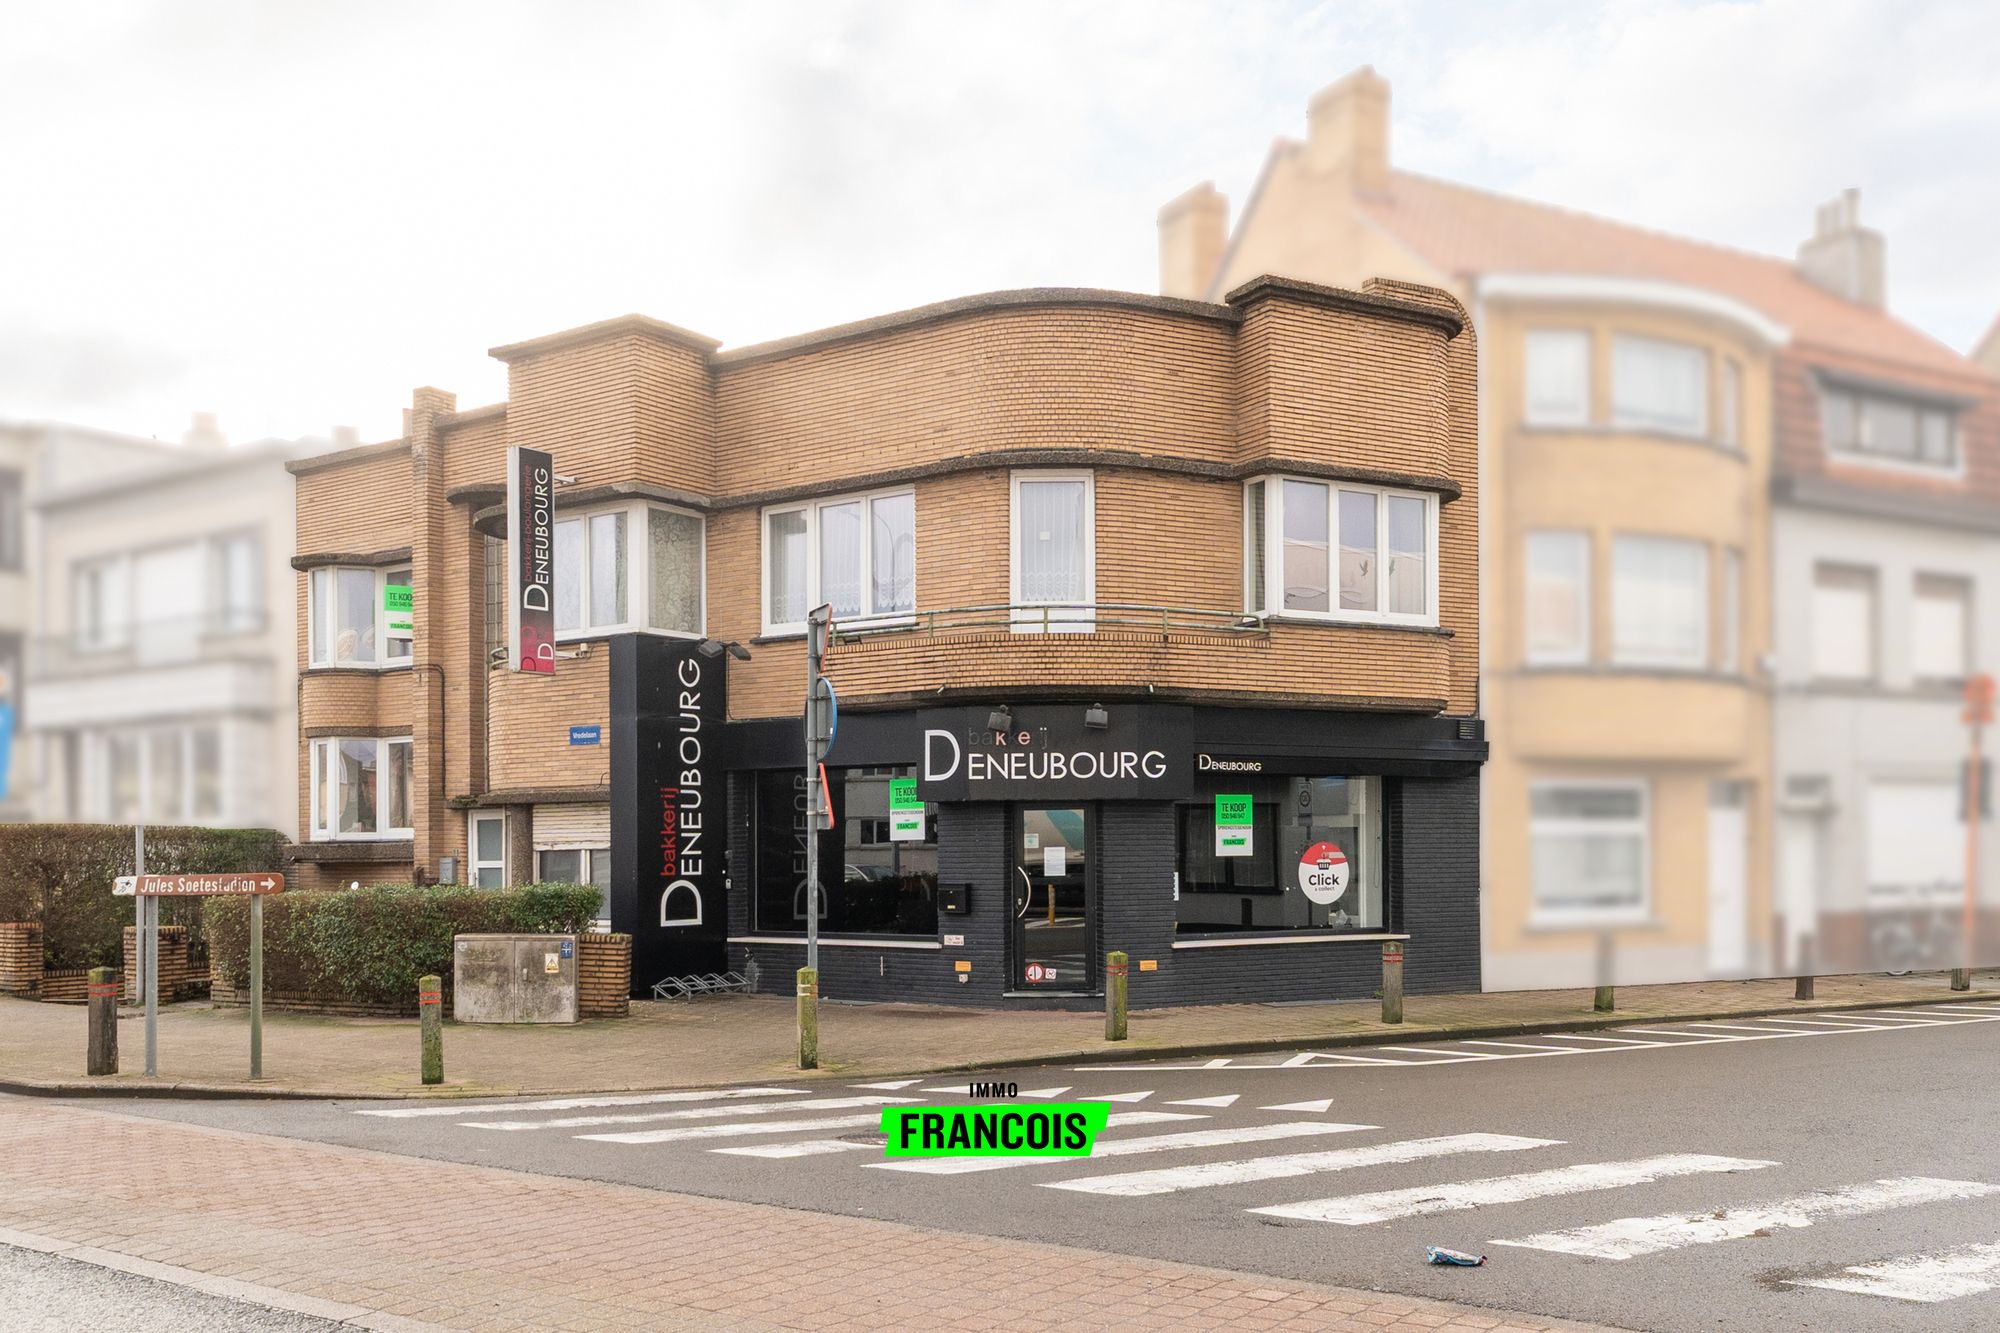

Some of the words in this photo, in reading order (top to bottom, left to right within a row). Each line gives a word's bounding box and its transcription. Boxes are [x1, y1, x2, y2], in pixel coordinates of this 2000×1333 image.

[524, 467, 549, 612] DENEUBOURG
[390, 592, 397, 600] TE
[399, 593, 412, 601] KOO
[924, 729, 1167, 781] DENEUBOURG
[1199, 754, 1262, 772] DENEUBOURG
[660, 658, 703, 927] DENEUBOURG
[895, 787, 902, 796] TE
[903, 787, 916, 796] KOO
[1221, 803, 1228, 812] TE
[1230, 803, 1247, 812] KOOP
[661, 786, 679, 877] bakkerij
[141, 877, 174, 893] Jules
[1308, 873, 1340, 886] Click
